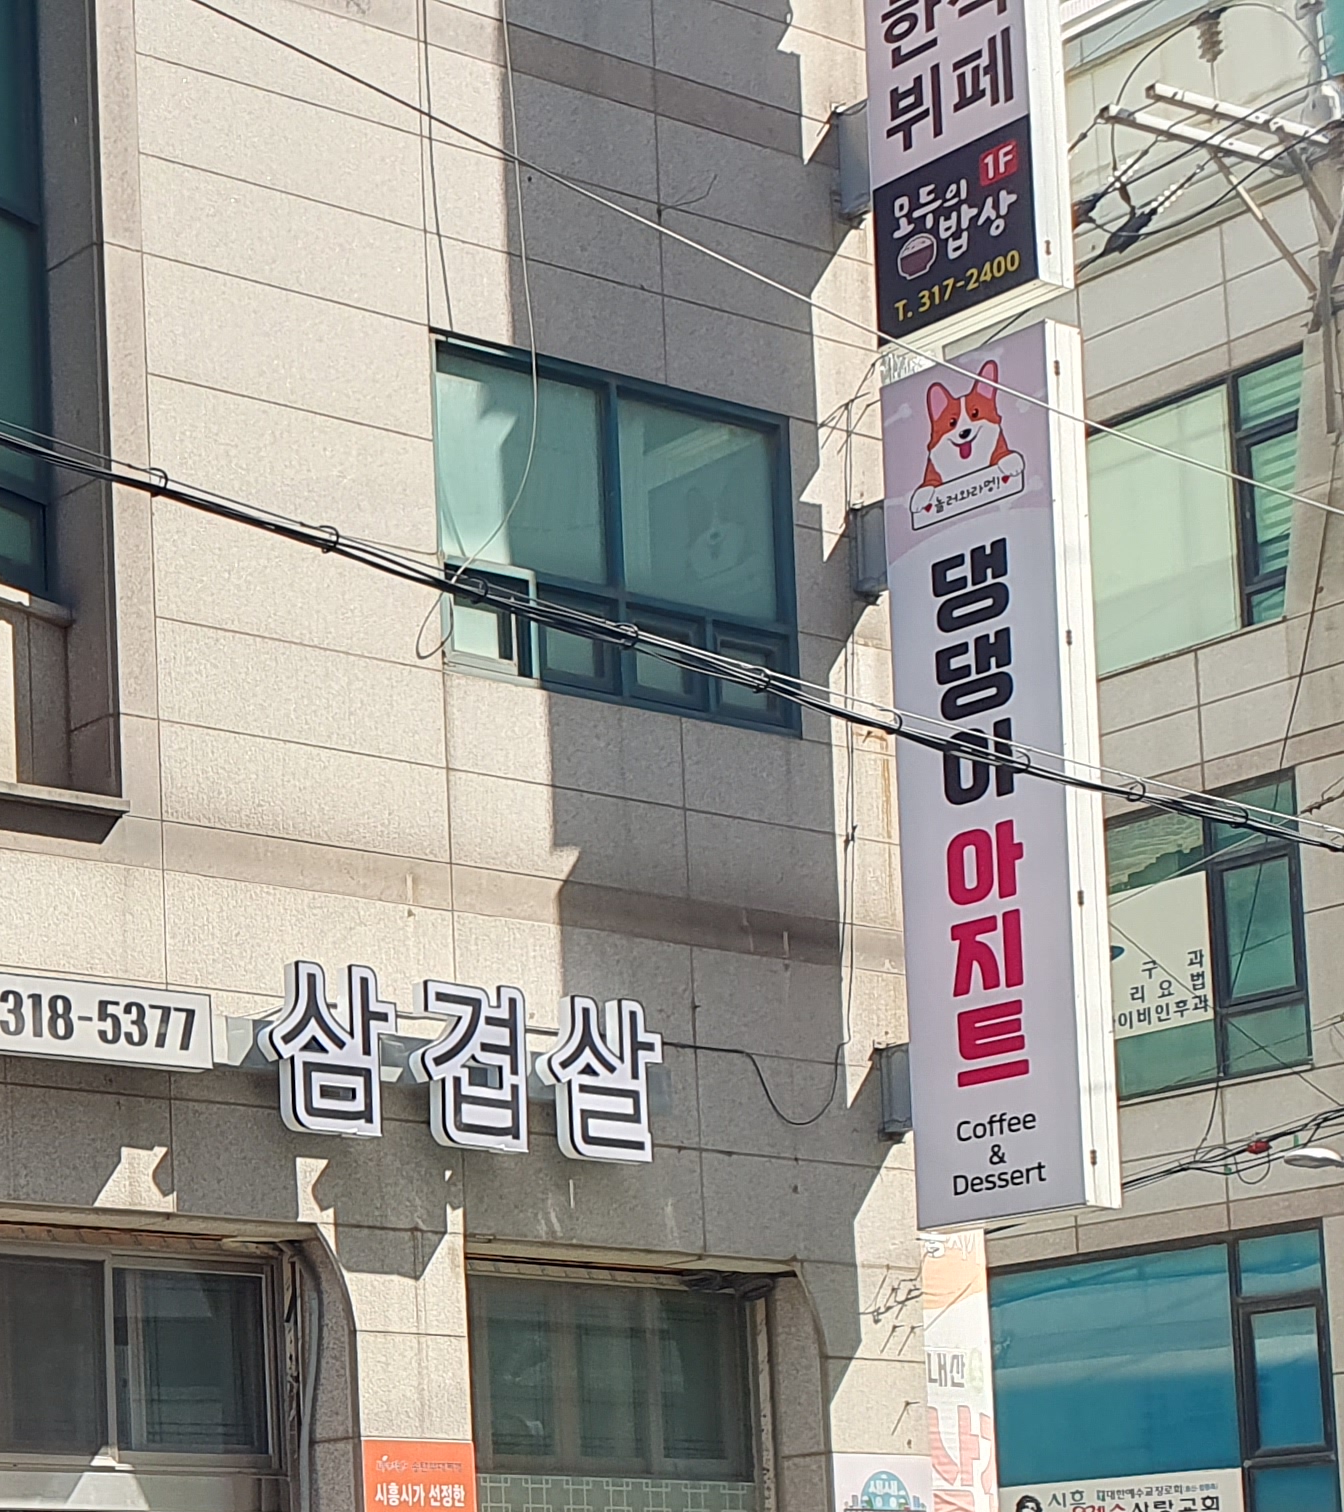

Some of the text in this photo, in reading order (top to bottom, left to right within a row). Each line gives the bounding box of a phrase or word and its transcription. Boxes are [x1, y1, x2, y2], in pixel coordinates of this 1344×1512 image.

[881, 0, 1008, 68] 한
[886, 26, 1014, 152] 뷔페
[983, 145, 1015, 180] 1F
[893, 179, 968, 238] 모두의
[939, 189, 1017, 260] 밥상
[918, 250, 1021, 314] 317-2400
[931, 537, 1016, 806] 댕댕이
[946, 819, 1030, 1088] 아지트
[1118, 993, 1209, 1030] 이비인후과
[258, 961, 663, 1163] 삼겹살
[956, 1111, 1038, 1143] Coffee
[989, 1143, 1007, 1166] &
[952, 1160, 1047, 1197] Dessert
[375, 1482, 466, 1507] 시흥시가 선정한
